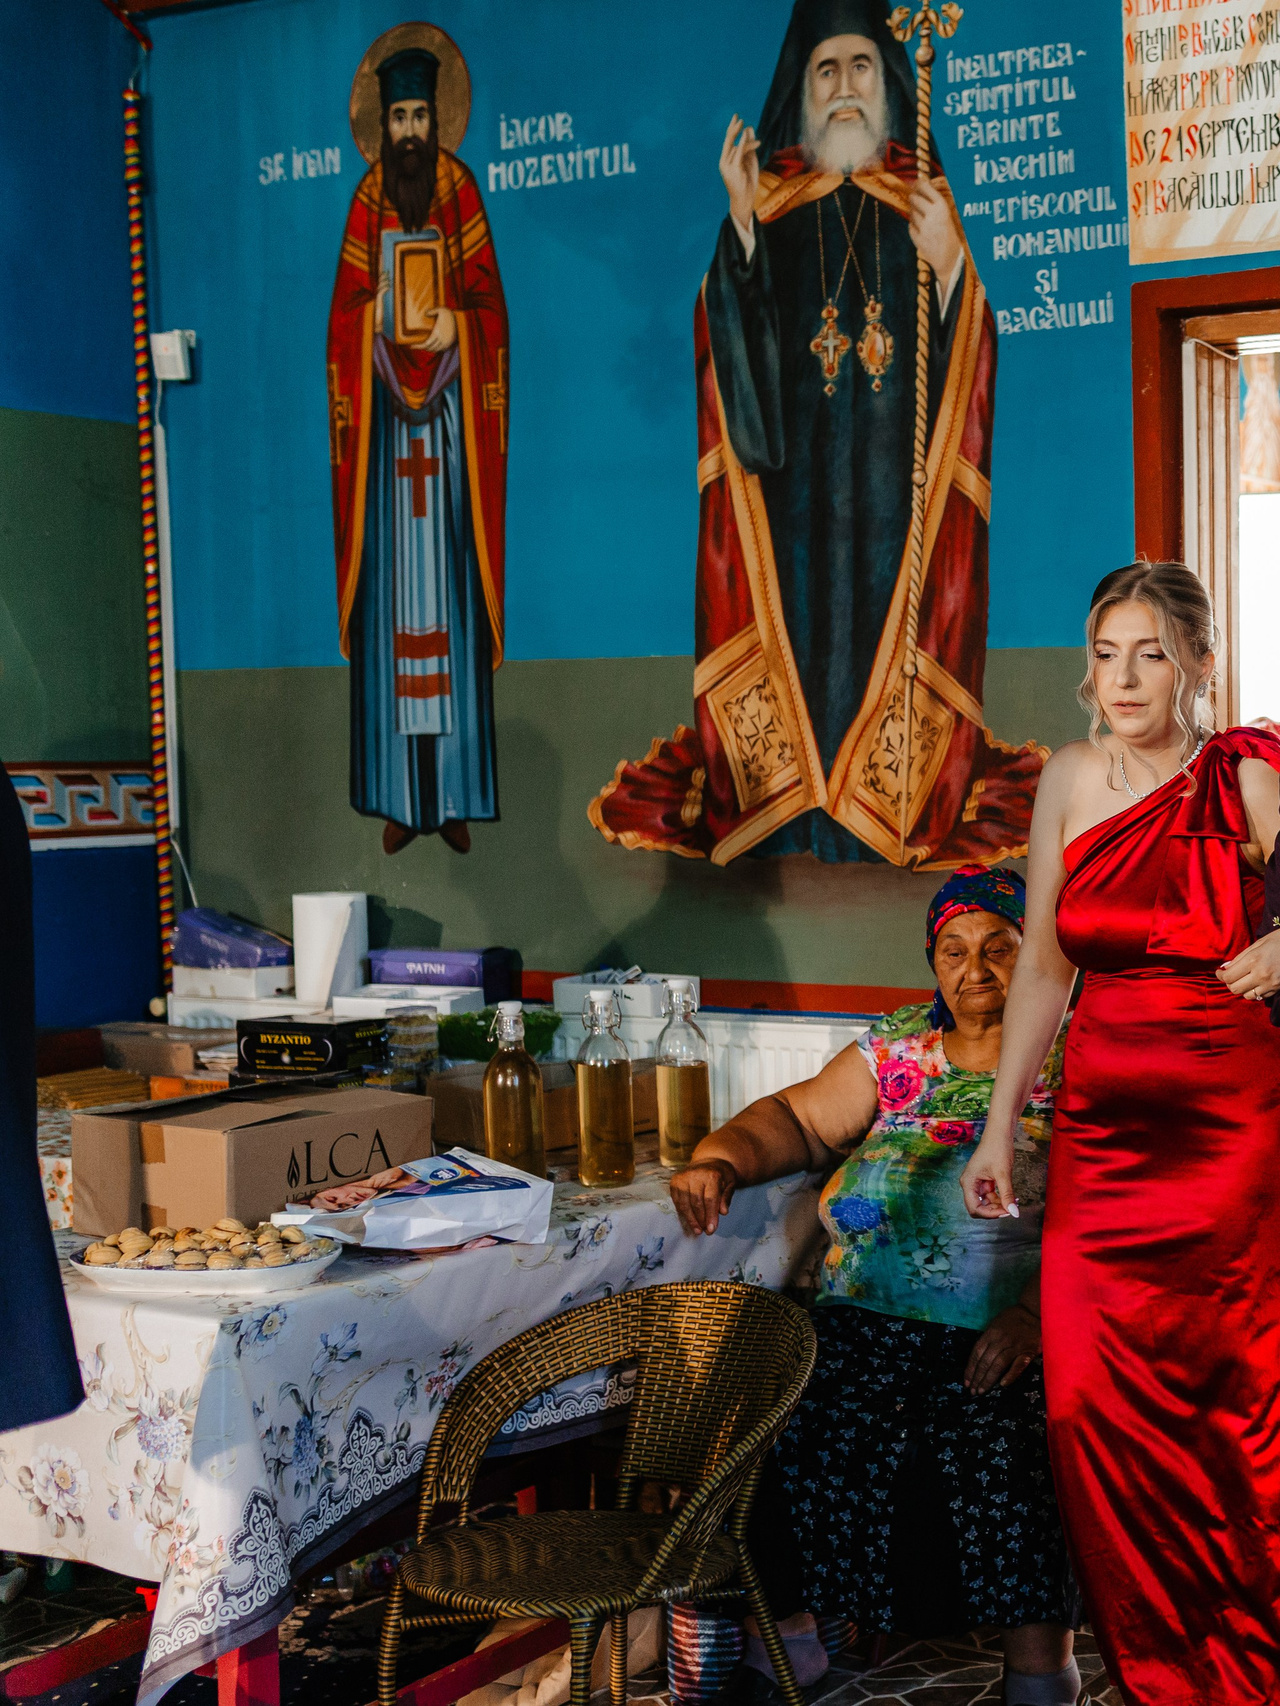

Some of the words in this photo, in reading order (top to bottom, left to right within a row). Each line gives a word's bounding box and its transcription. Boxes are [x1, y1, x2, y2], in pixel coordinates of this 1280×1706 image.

[1129, 129, 1156, 168] DE
[1160, 125, 1184, 163] 21
[260, 1033, 312, 1046] BYZANTIO
